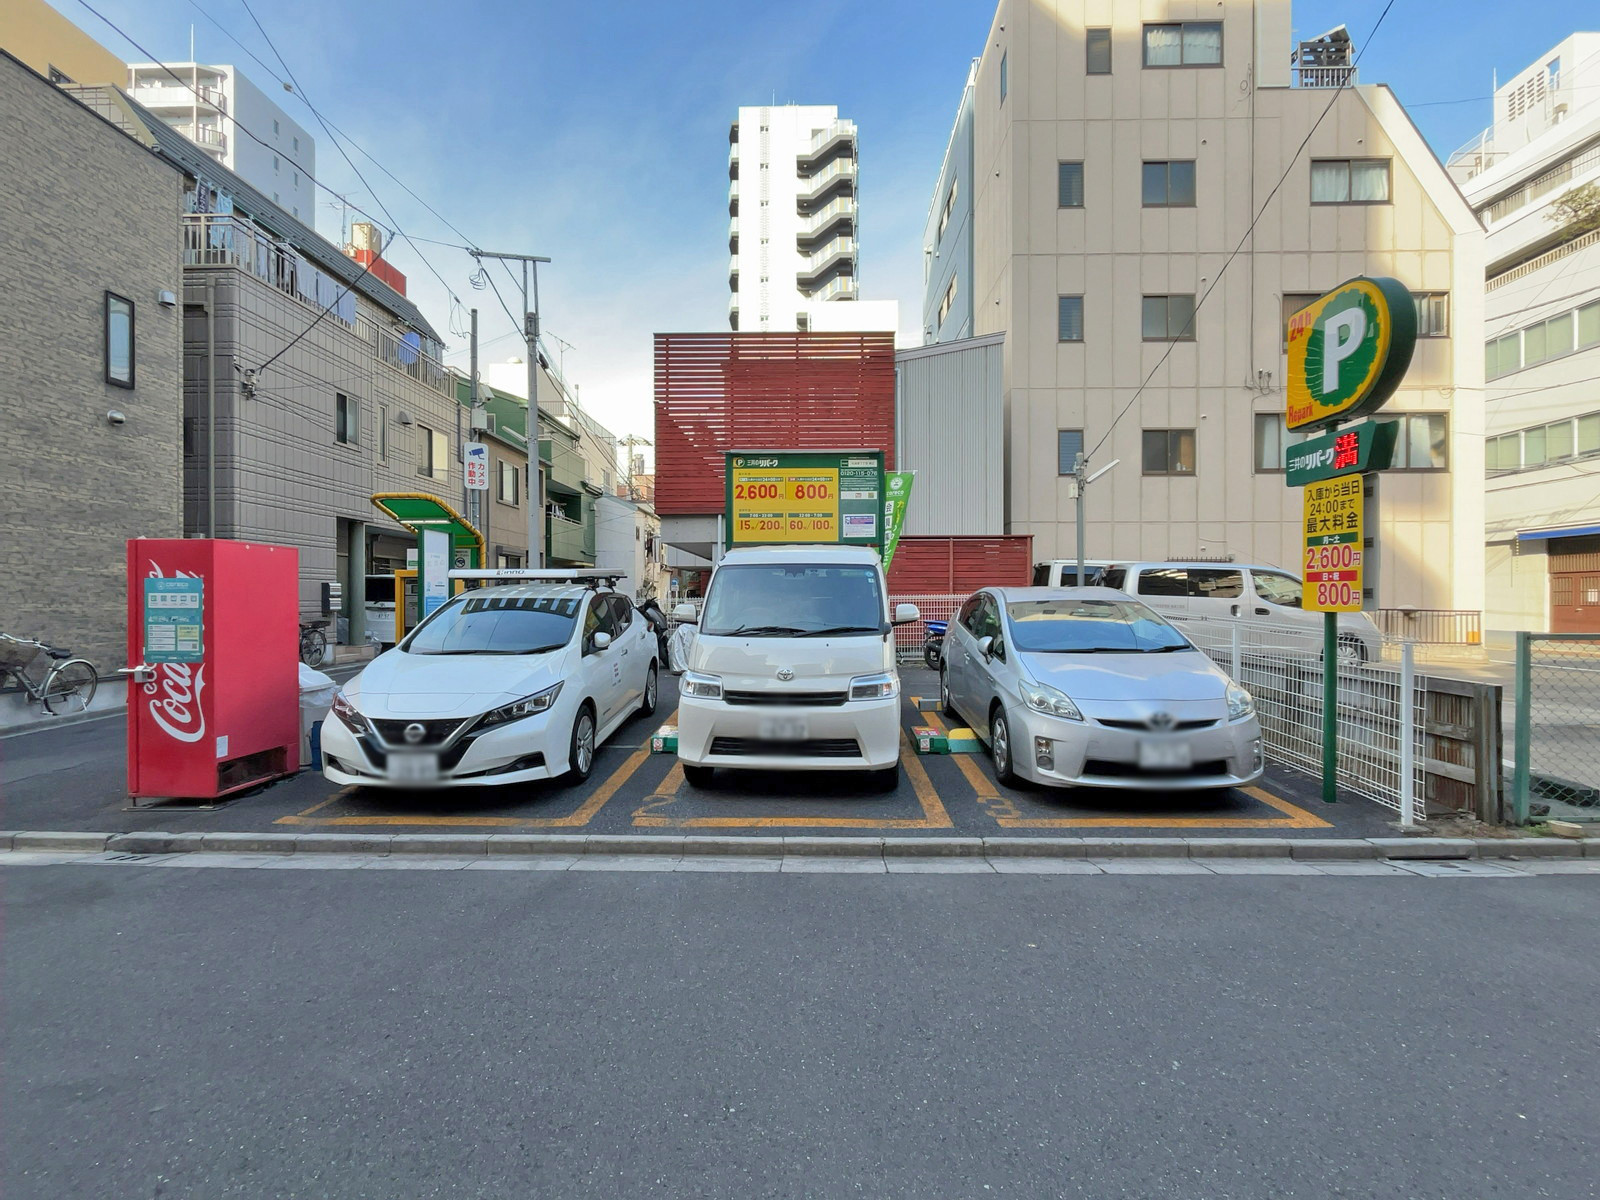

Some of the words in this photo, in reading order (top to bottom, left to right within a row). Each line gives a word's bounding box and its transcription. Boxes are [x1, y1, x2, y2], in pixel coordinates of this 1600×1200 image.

[1290, 311, 1311, 342] 24h
[1323, 307, 1367, 394] P
[1288, 402, 1313, 425] Repark
[1288, 448, 1334, 472] 三井のリパーク
[1334, 431, 1359, 470] 満
[468, 462, 476, 486] 作動中
[1307, 480, 1360, 502] 入庫から当日
[1310, 498, 1355, 516] 24:00まで
[1307, 511, 1358, 533] 最大料金
[1306, 545, 1361, 570] 2,600円
[1317, 582, 1360, 606] 800円
[631, 794, 677, 818] 2
[976, 796, 1022, 819] 3
